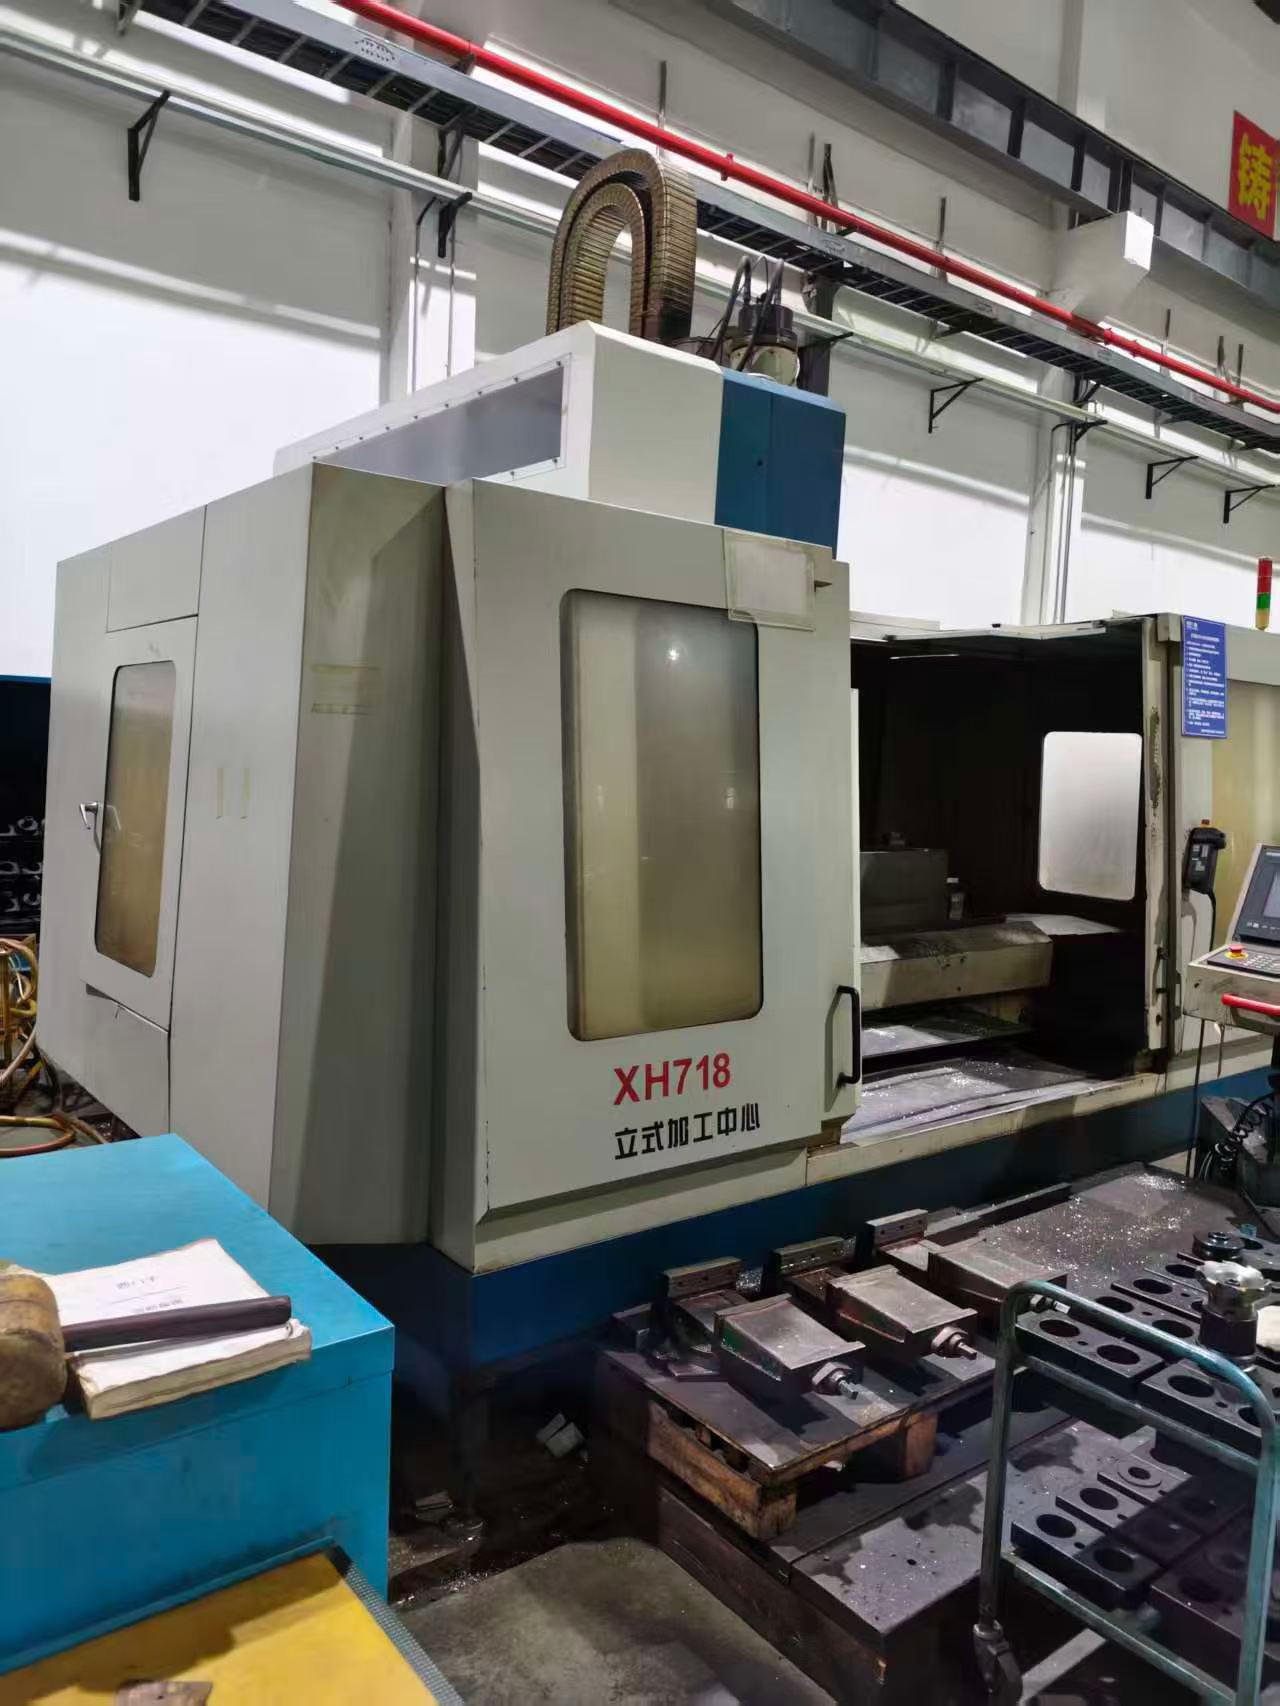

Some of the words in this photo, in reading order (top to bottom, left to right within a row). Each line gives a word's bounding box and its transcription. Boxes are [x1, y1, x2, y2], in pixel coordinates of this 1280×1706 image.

[1239, 132, 1271, 220] 铸
[613, 1052, 731, 1106] XH718
[614, 1102, 761, 1160] 立式加工中心
